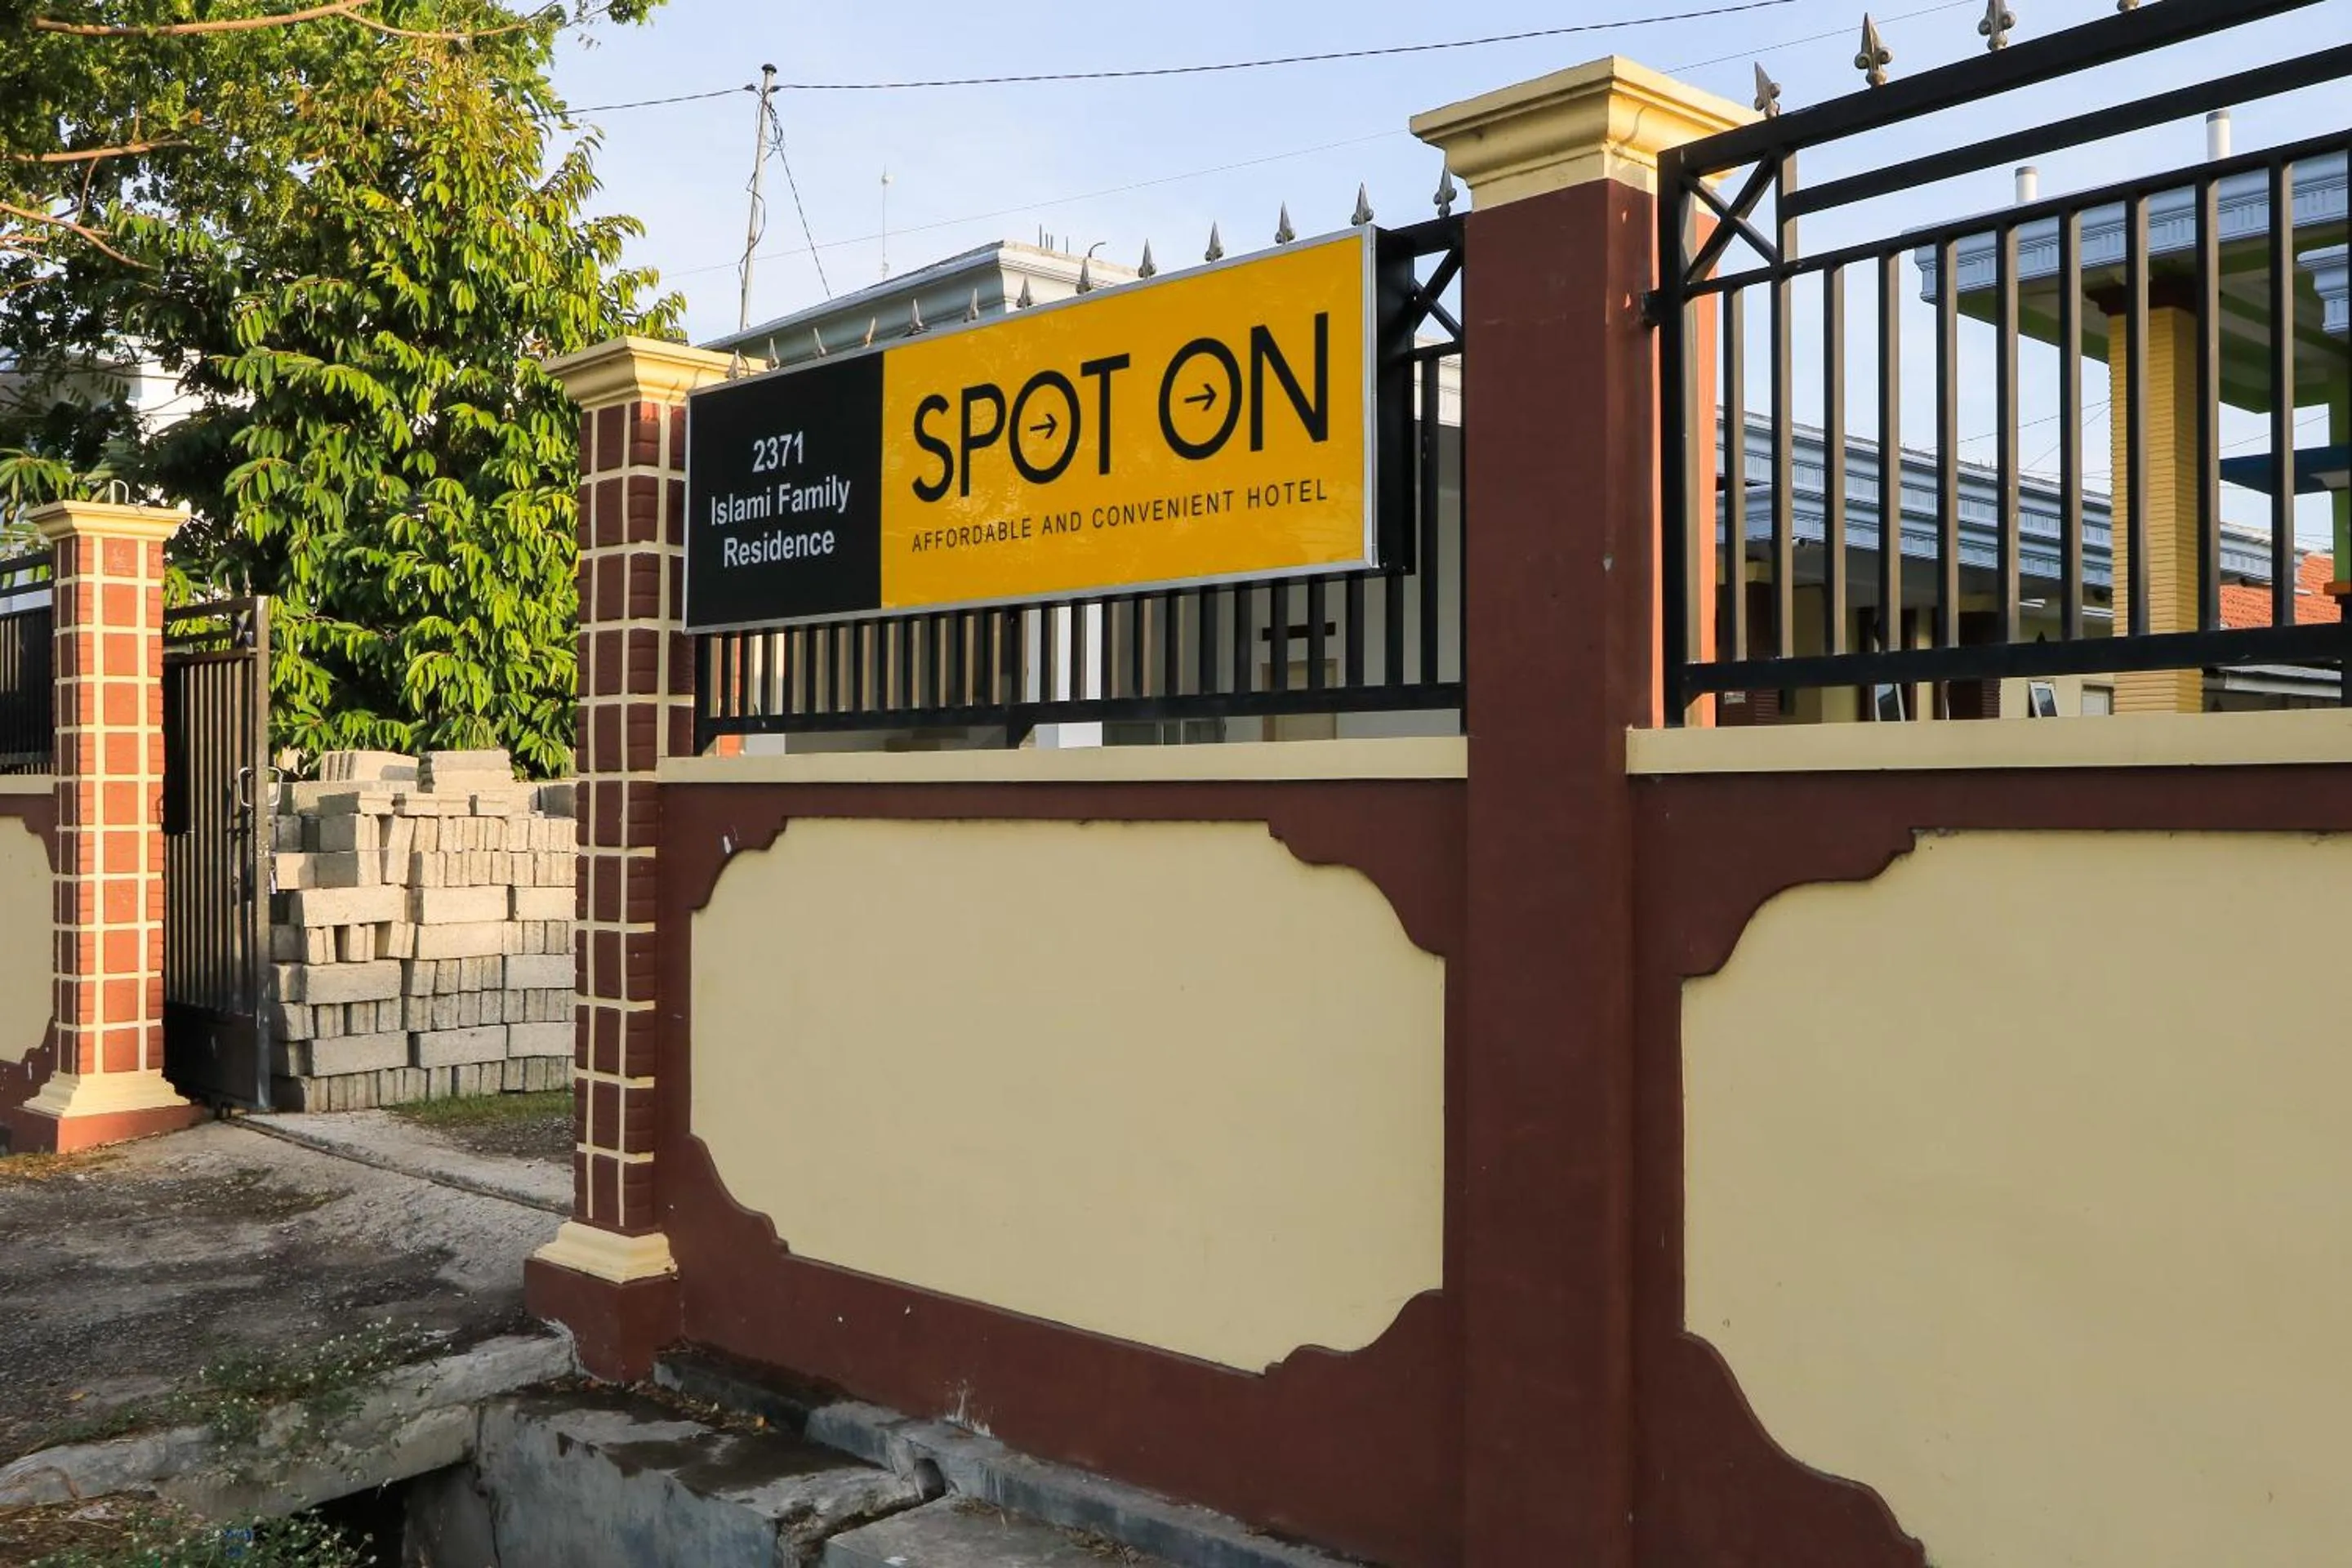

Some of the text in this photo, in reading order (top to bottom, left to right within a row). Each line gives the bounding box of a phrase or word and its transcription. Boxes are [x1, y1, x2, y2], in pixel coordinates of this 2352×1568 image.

[911, 312, 1329, 503] SPOT ON
[752, 431, 803, 472] 2371
[711, 474, 851, 526] Islami Family
[911, 479, 1328, 553] AFFORDABLE AND CONVENIENT HOTEL
[724, 530, 835, 568] Residence
